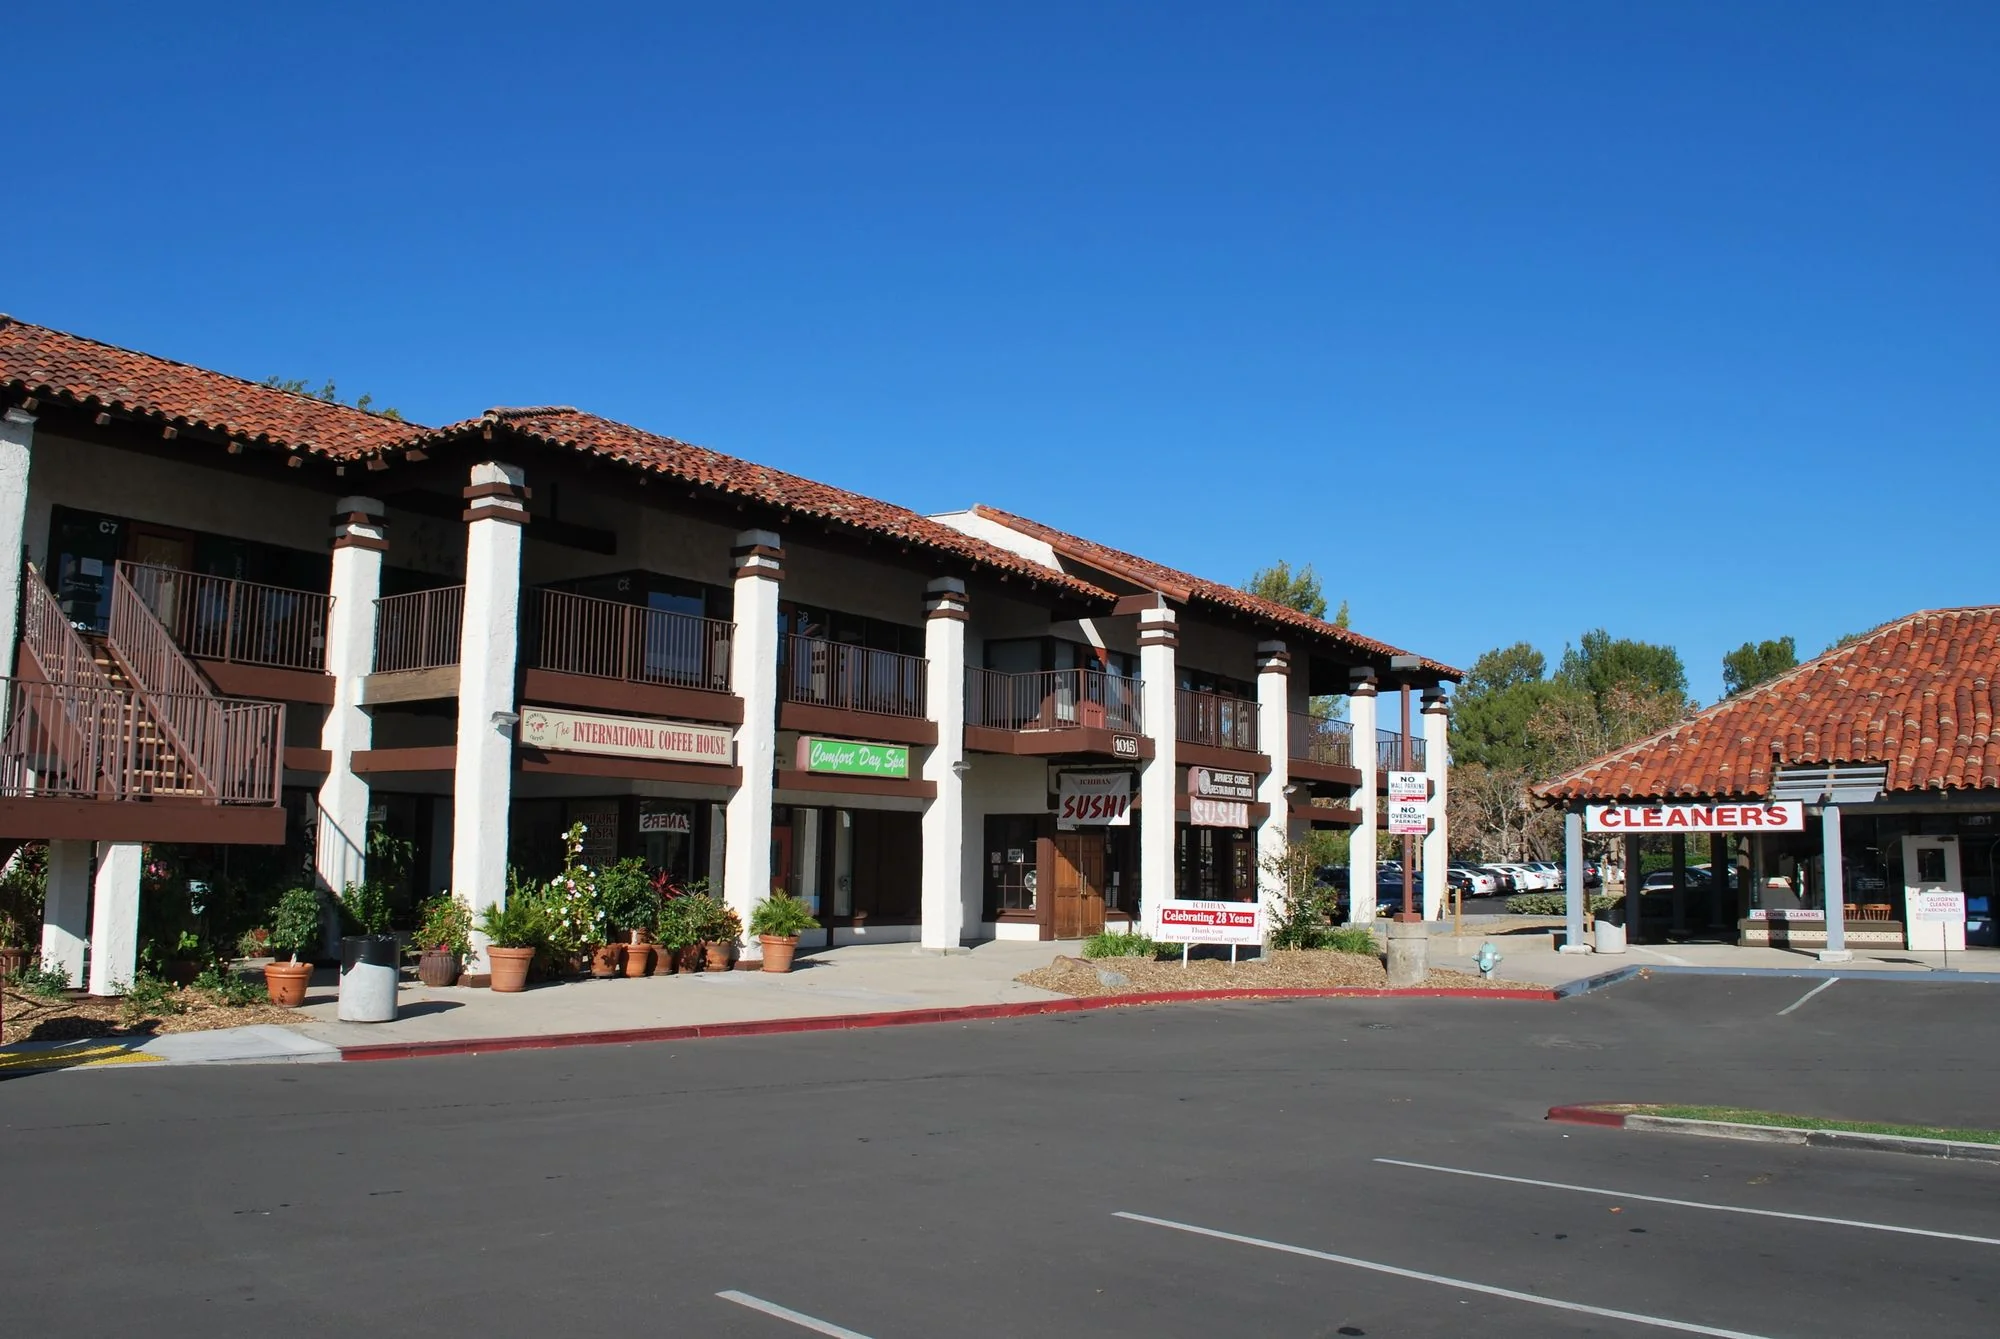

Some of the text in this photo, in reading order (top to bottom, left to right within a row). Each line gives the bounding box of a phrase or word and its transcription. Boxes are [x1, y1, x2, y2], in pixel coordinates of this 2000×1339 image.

[100, 520, 118, 535] C7
[553, 721, 726, 755] The INTERNATIONAL COFFEE HOUSE
[1115, 739, 1136, 754] 1015
[810, 742, 904, 772] Comfort Day Spa
[1062, 794, 1127, 819] SUSHI
[1193, 800, 1248, 825] SUSHI
[1599, 806, 1788, 827] CLEANERS
[1192, 902, 1226, 910] ICHIBAN
[1163, 910, 1253, 924] Celebrating 28 Years
[1192, 934, 1222, 942] continued
